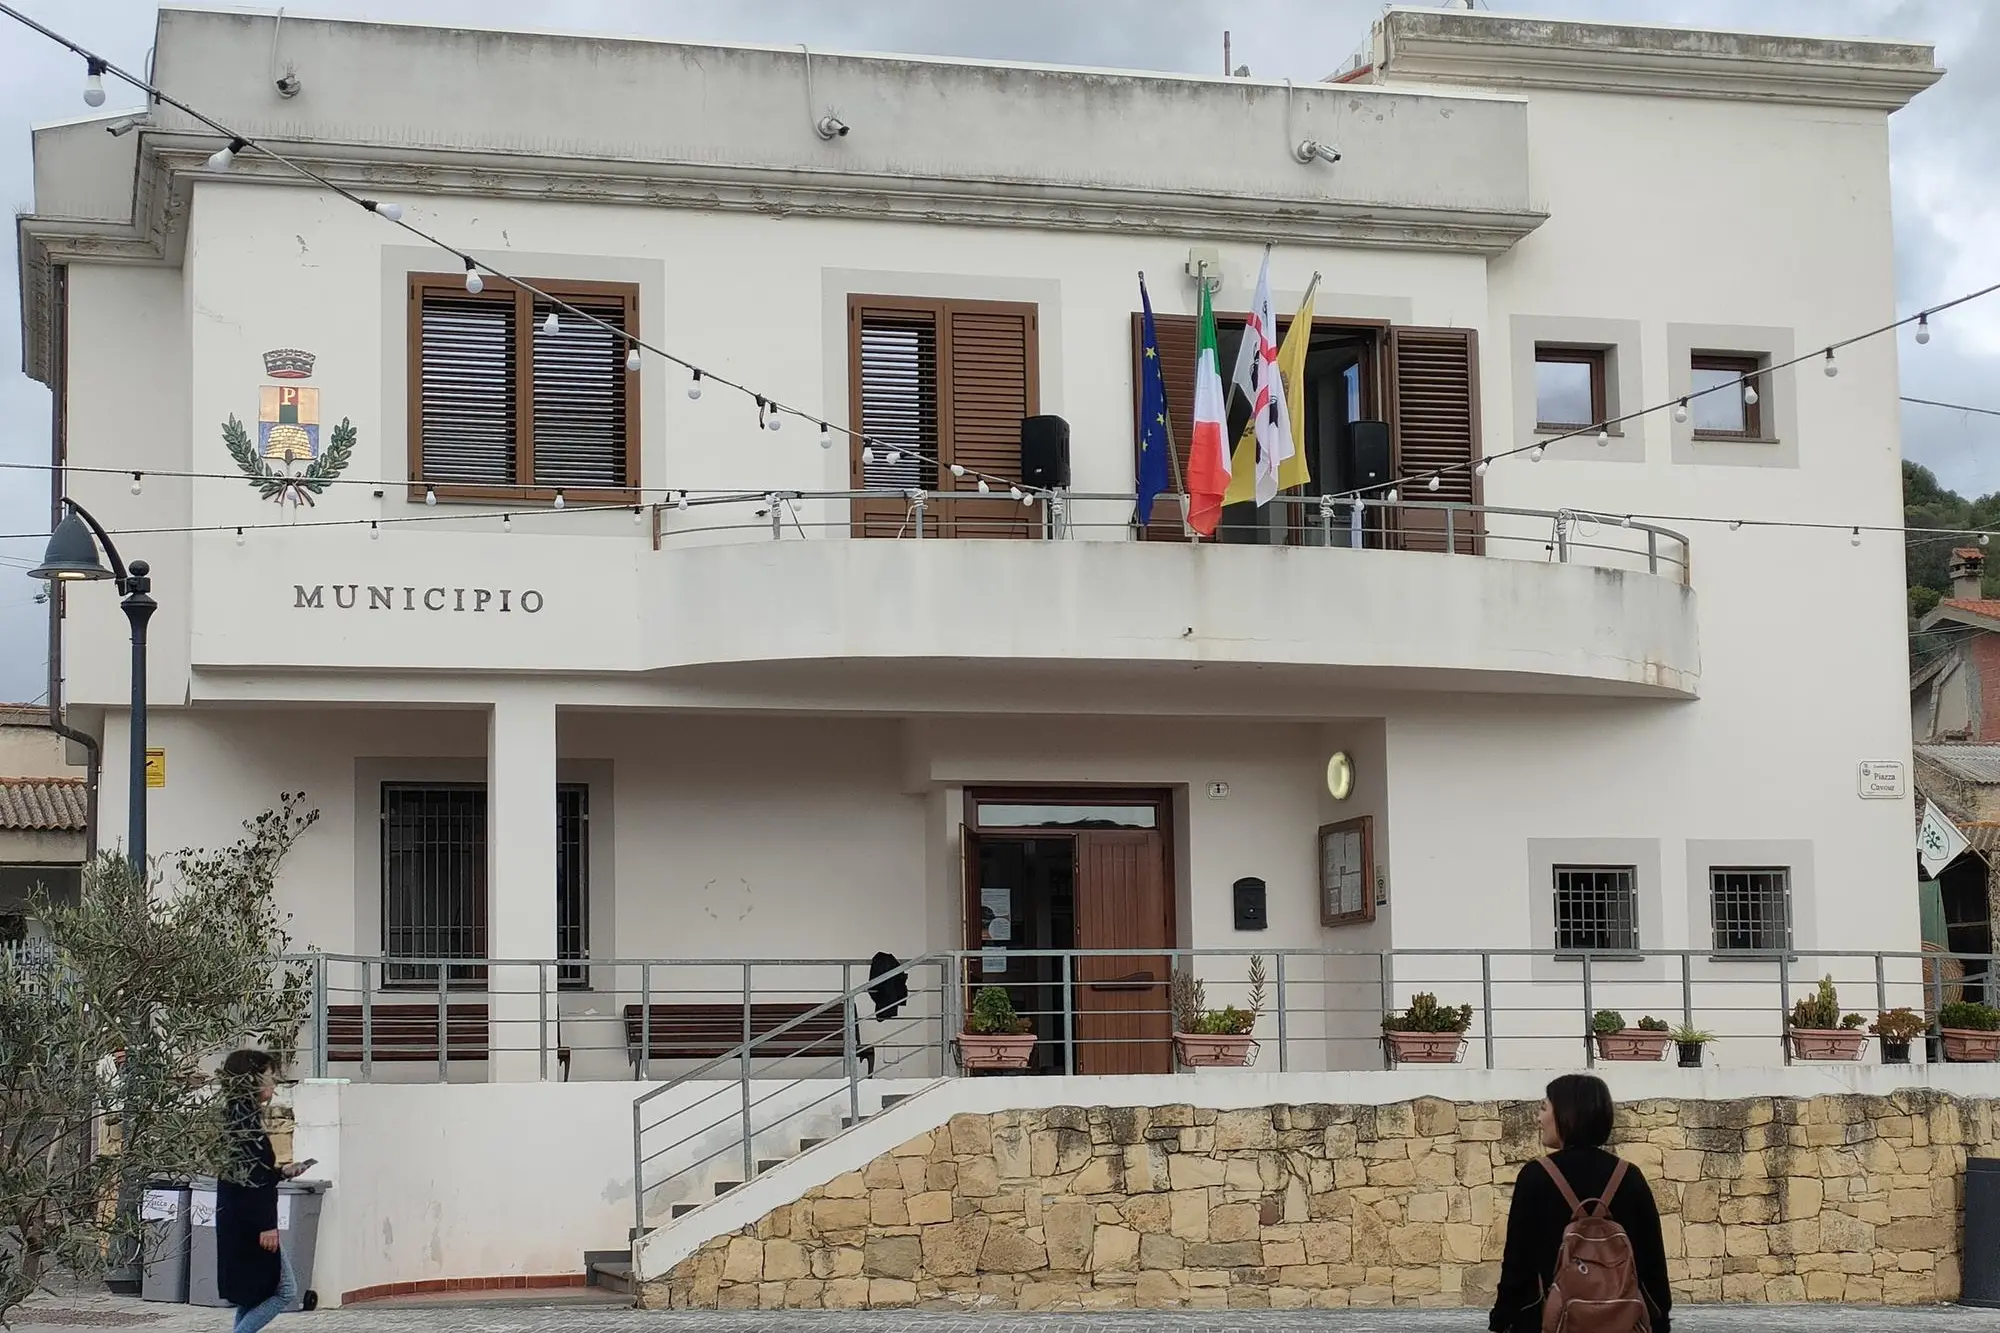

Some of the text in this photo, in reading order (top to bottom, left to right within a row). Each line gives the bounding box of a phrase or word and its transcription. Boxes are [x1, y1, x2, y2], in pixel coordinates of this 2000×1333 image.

[281, 387, 296, 405] P
[293, 584, 544, 613] MUNICIPIO
[1873, 772, 1896, 780] Piazza
[1870, 783, 1895, 791] Cavour
